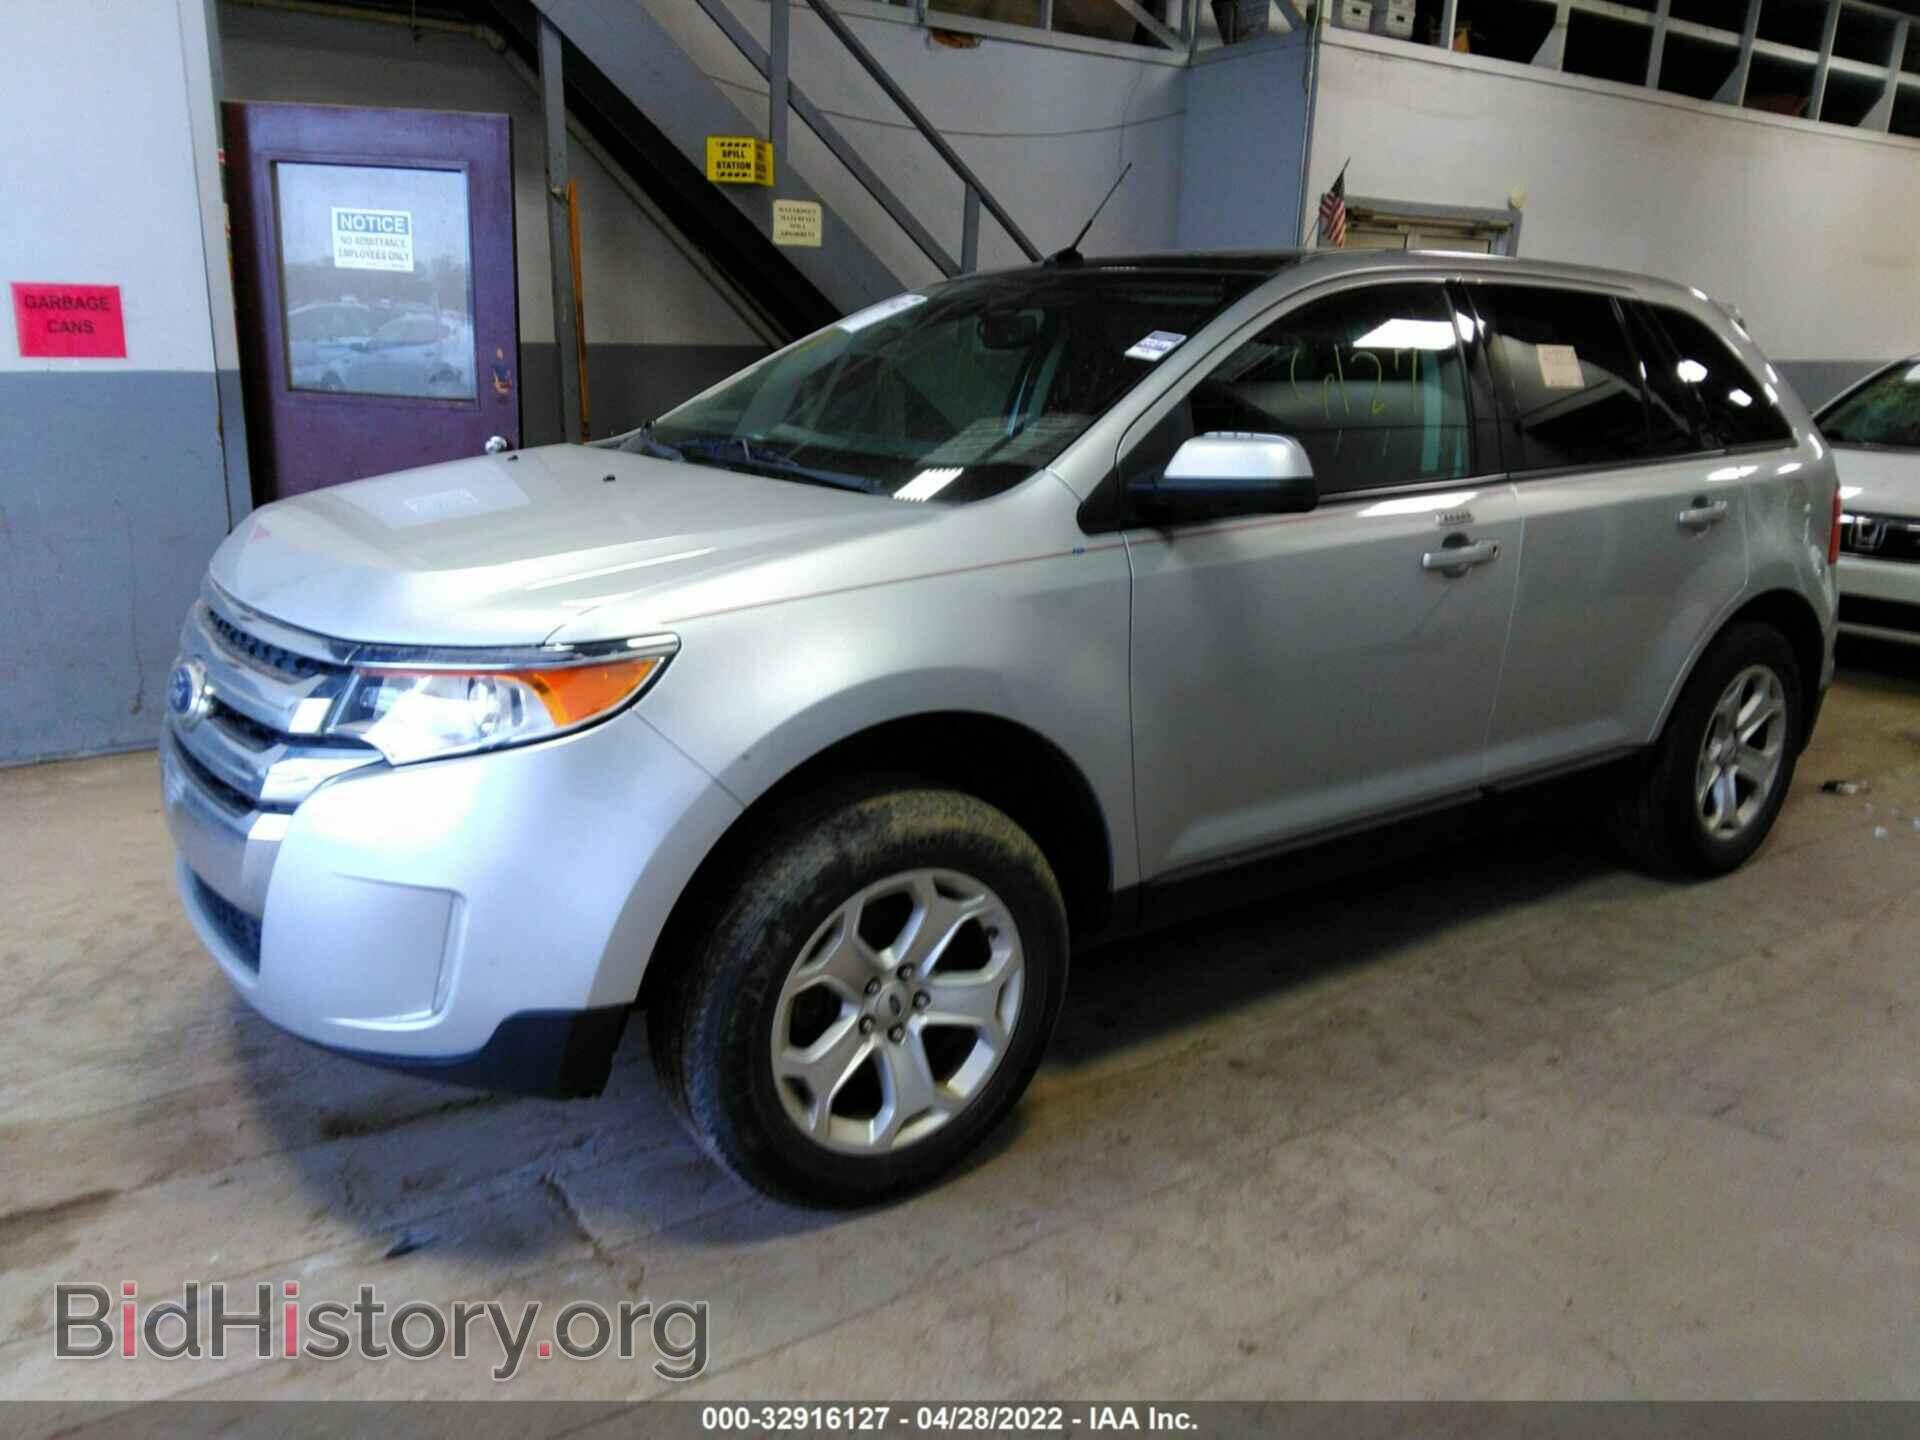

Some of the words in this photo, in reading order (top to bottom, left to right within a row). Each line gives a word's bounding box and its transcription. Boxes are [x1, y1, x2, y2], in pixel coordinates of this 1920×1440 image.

[722, 150, 745, 158] SPILL
[716, 160, 751, 169] STATION
[340, 213, 406, 233] NOTICE
[338, 248, 387, 260] EMPLOYEES
[388, 250, 409, 262] ONLY
[24, 294, 110, 312] GARBAGE
[47, 319, 94, 334] CANS
